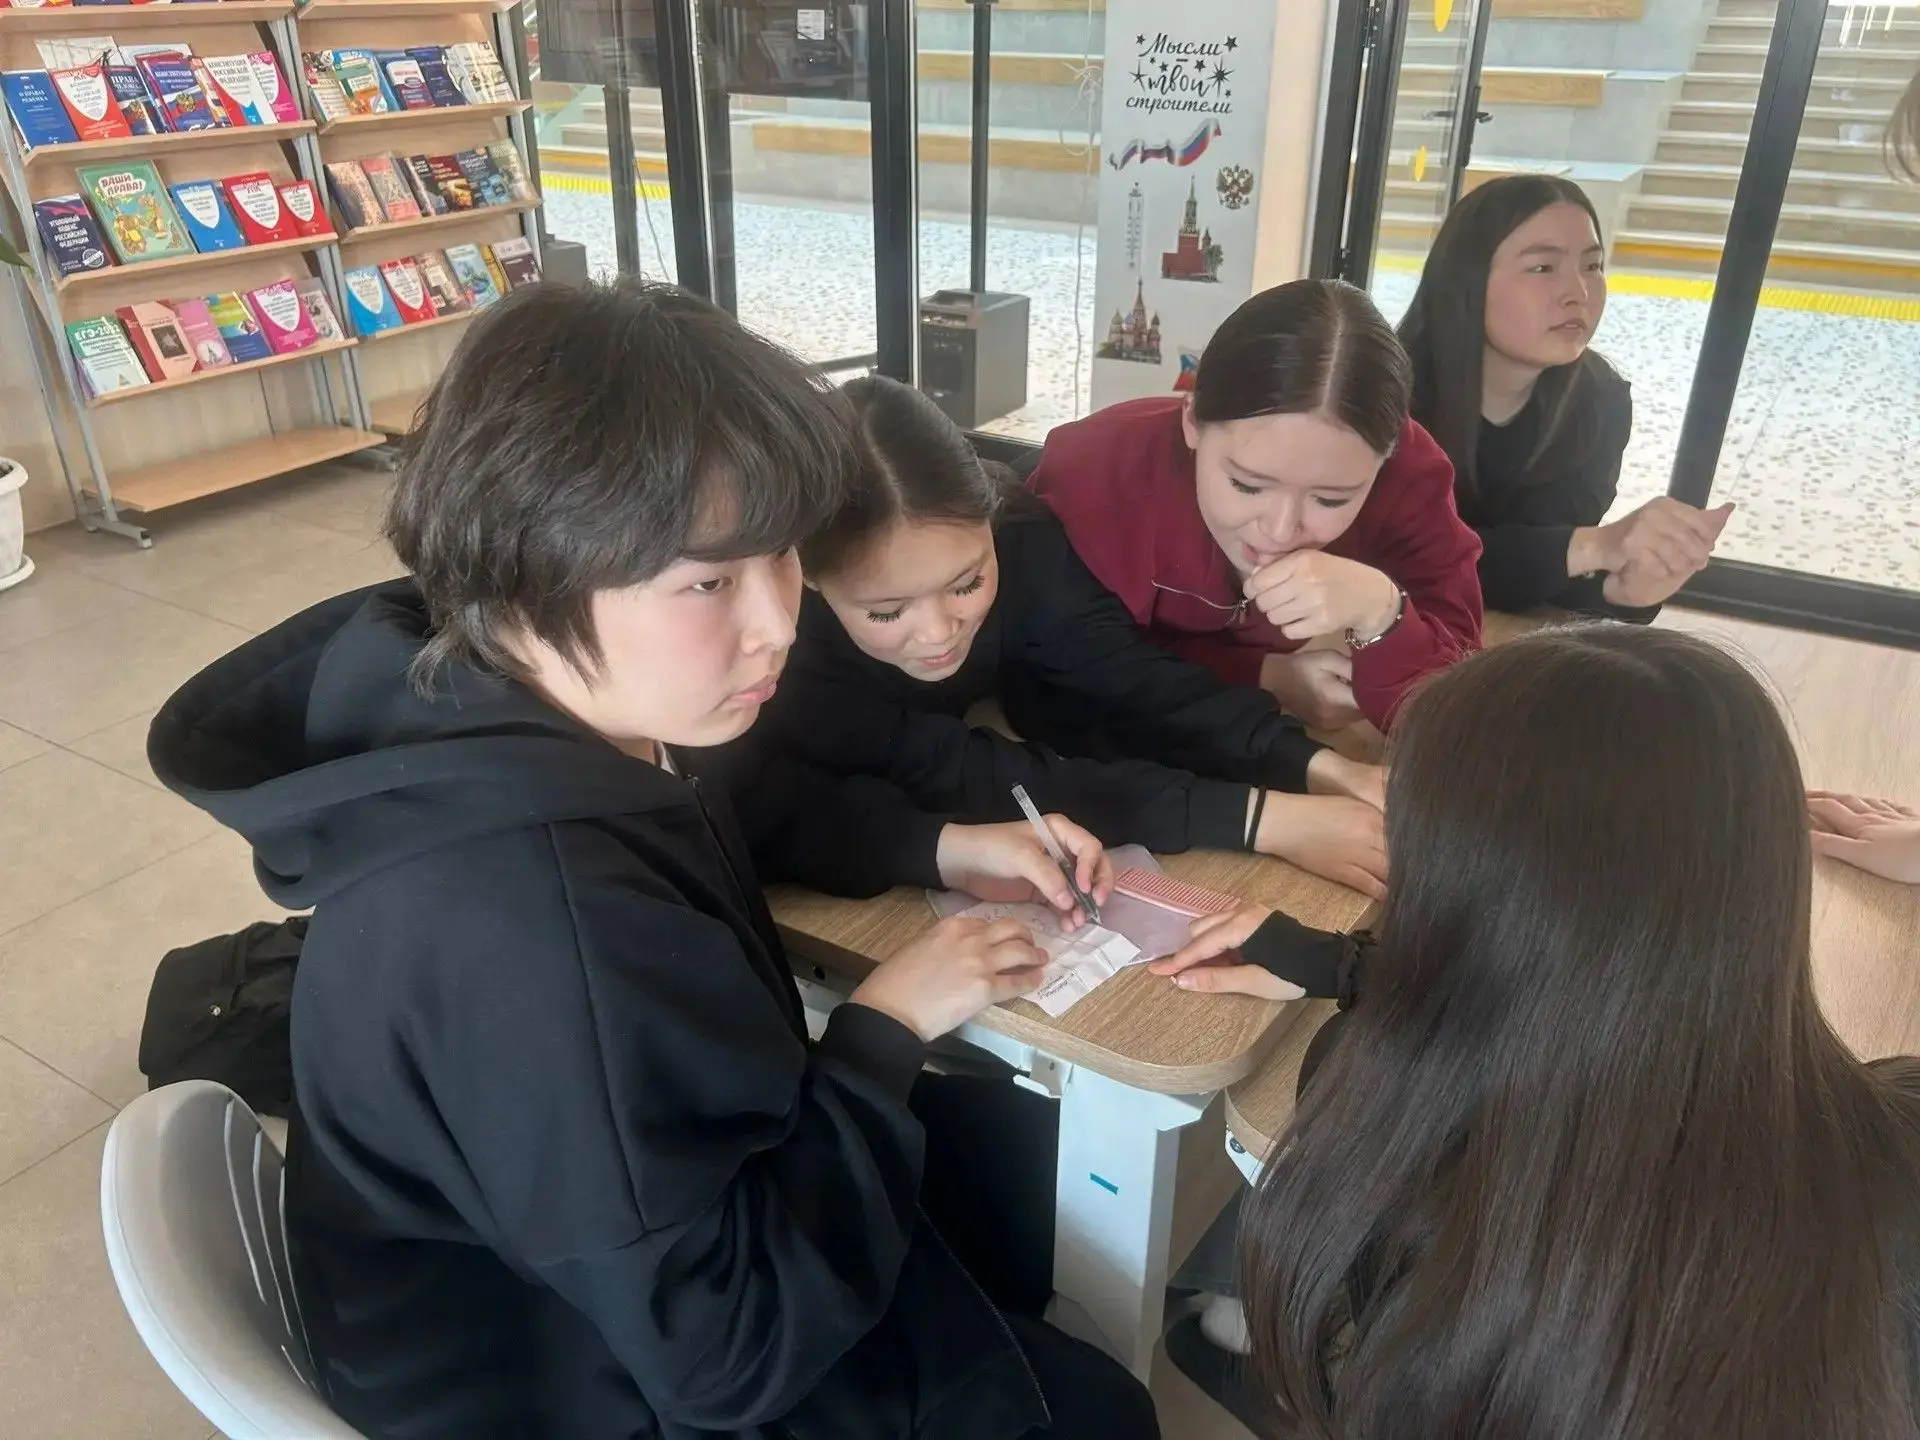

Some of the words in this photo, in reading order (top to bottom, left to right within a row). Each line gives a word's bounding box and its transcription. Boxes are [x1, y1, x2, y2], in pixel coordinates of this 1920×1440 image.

[1138, 33, 1222, 57] Мысли
[1148, 65, 1211, 97] твои
[1126, 96, 1233, 115] строители
[101, 174, 131, 188] ВАШИ
[106, 182, 143, 196] ПРАВА!
